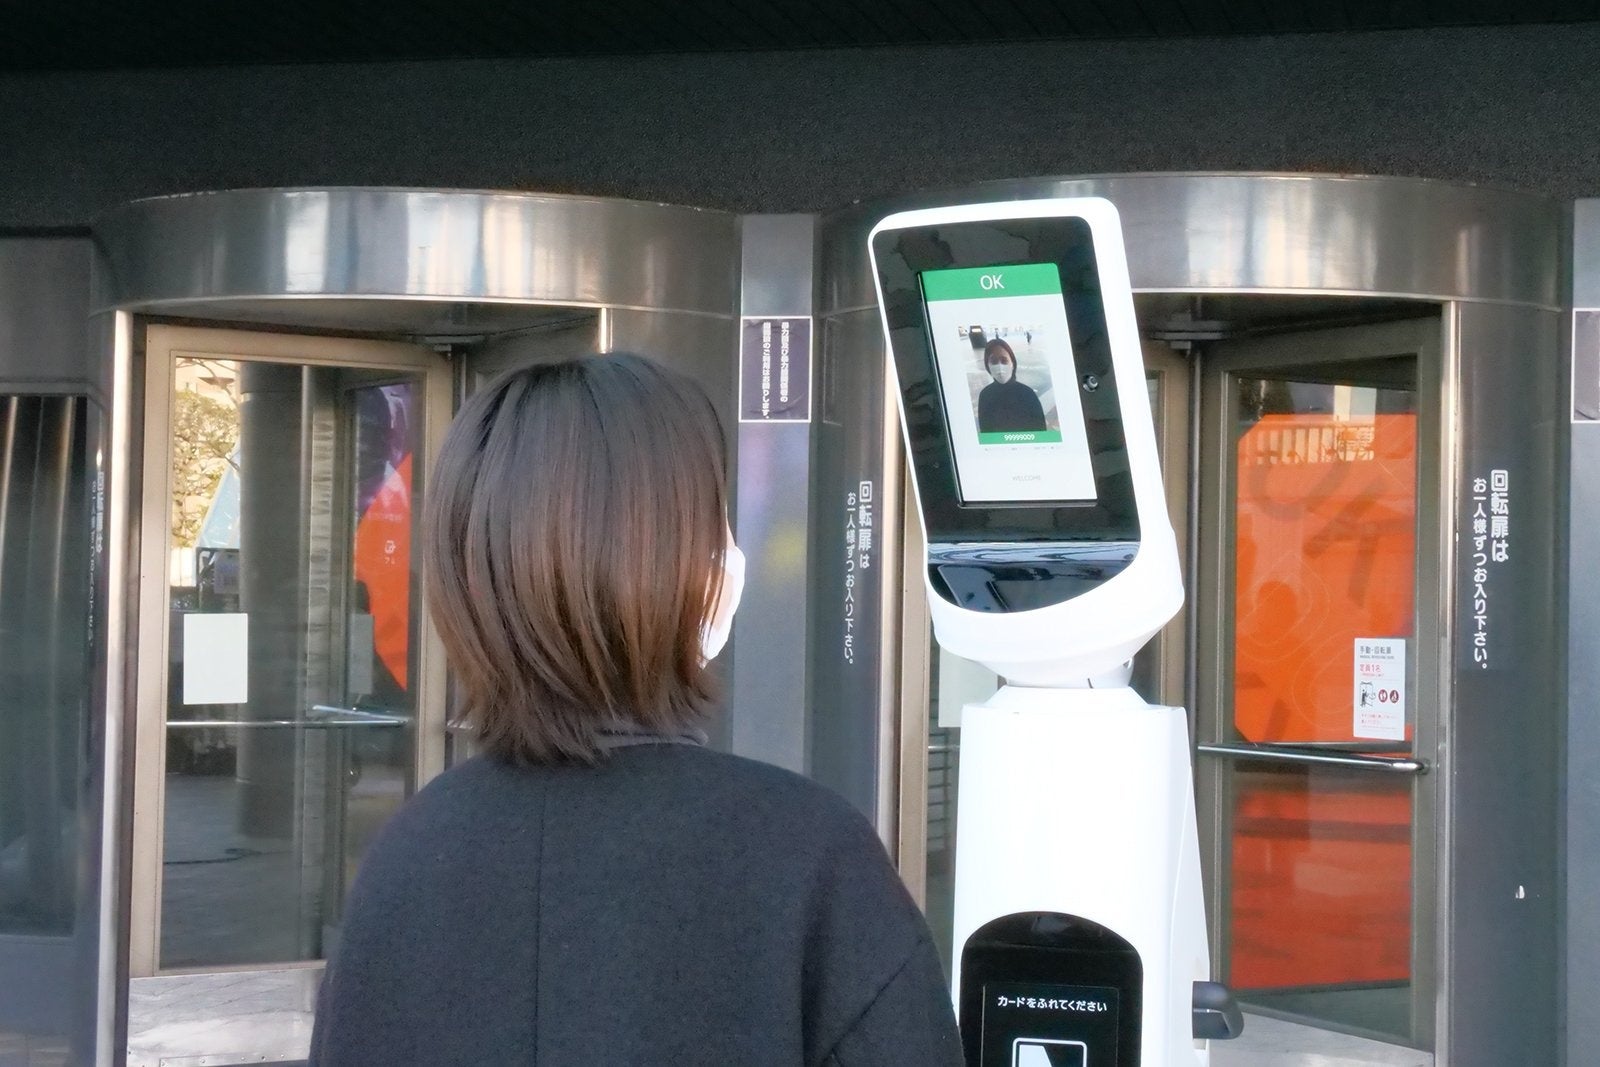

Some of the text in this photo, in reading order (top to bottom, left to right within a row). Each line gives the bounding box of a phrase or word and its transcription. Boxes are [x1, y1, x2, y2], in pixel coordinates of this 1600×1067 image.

[980, 274, 1005, 290] OK
[858, 480, 873, 569] 回転扉は
[1490, 469, 1509, 563] 回転扉は
[844, 491, 856, 664] お一人様ずつお入り下さい。
[1473, 477, 1488, 669] お一人様ずつお入り下さい。
[997, 995, 1108, 1012] カードをふれてください
